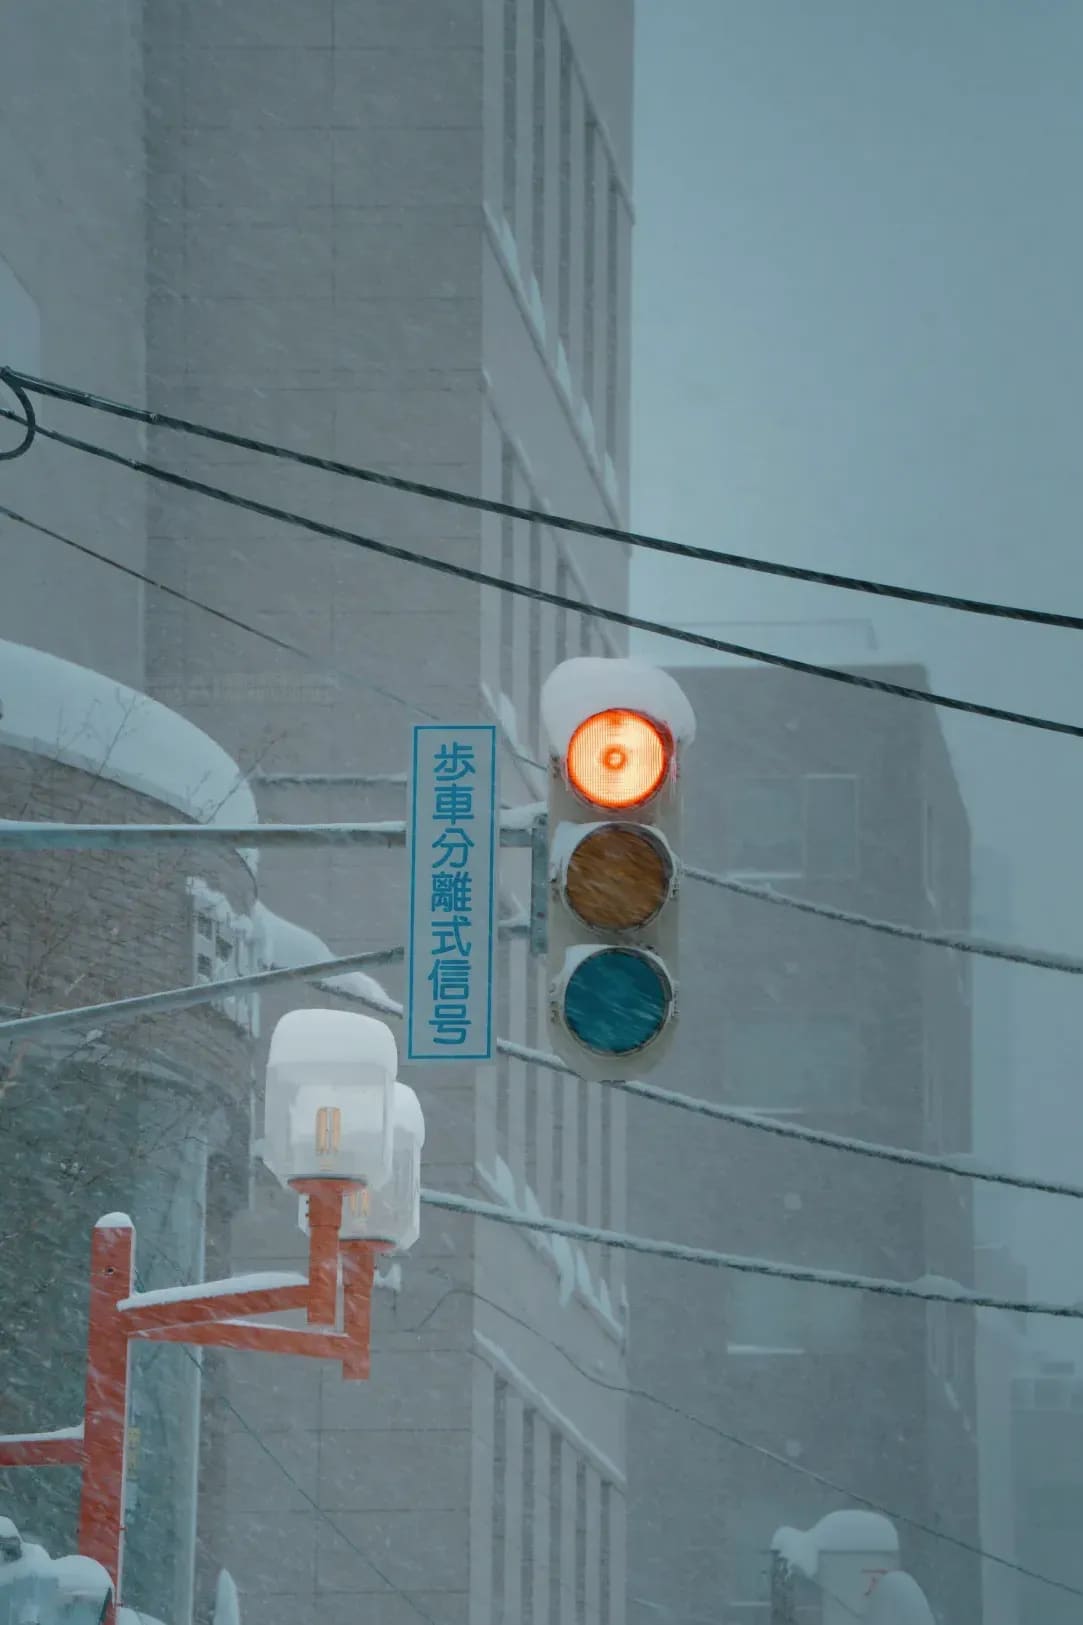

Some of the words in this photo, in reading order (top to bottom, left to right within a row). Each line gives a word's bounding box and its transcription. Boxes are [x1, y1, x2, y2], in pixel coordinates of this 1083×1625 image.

[428, 741, 476, 1046] 歩車分離式信号
